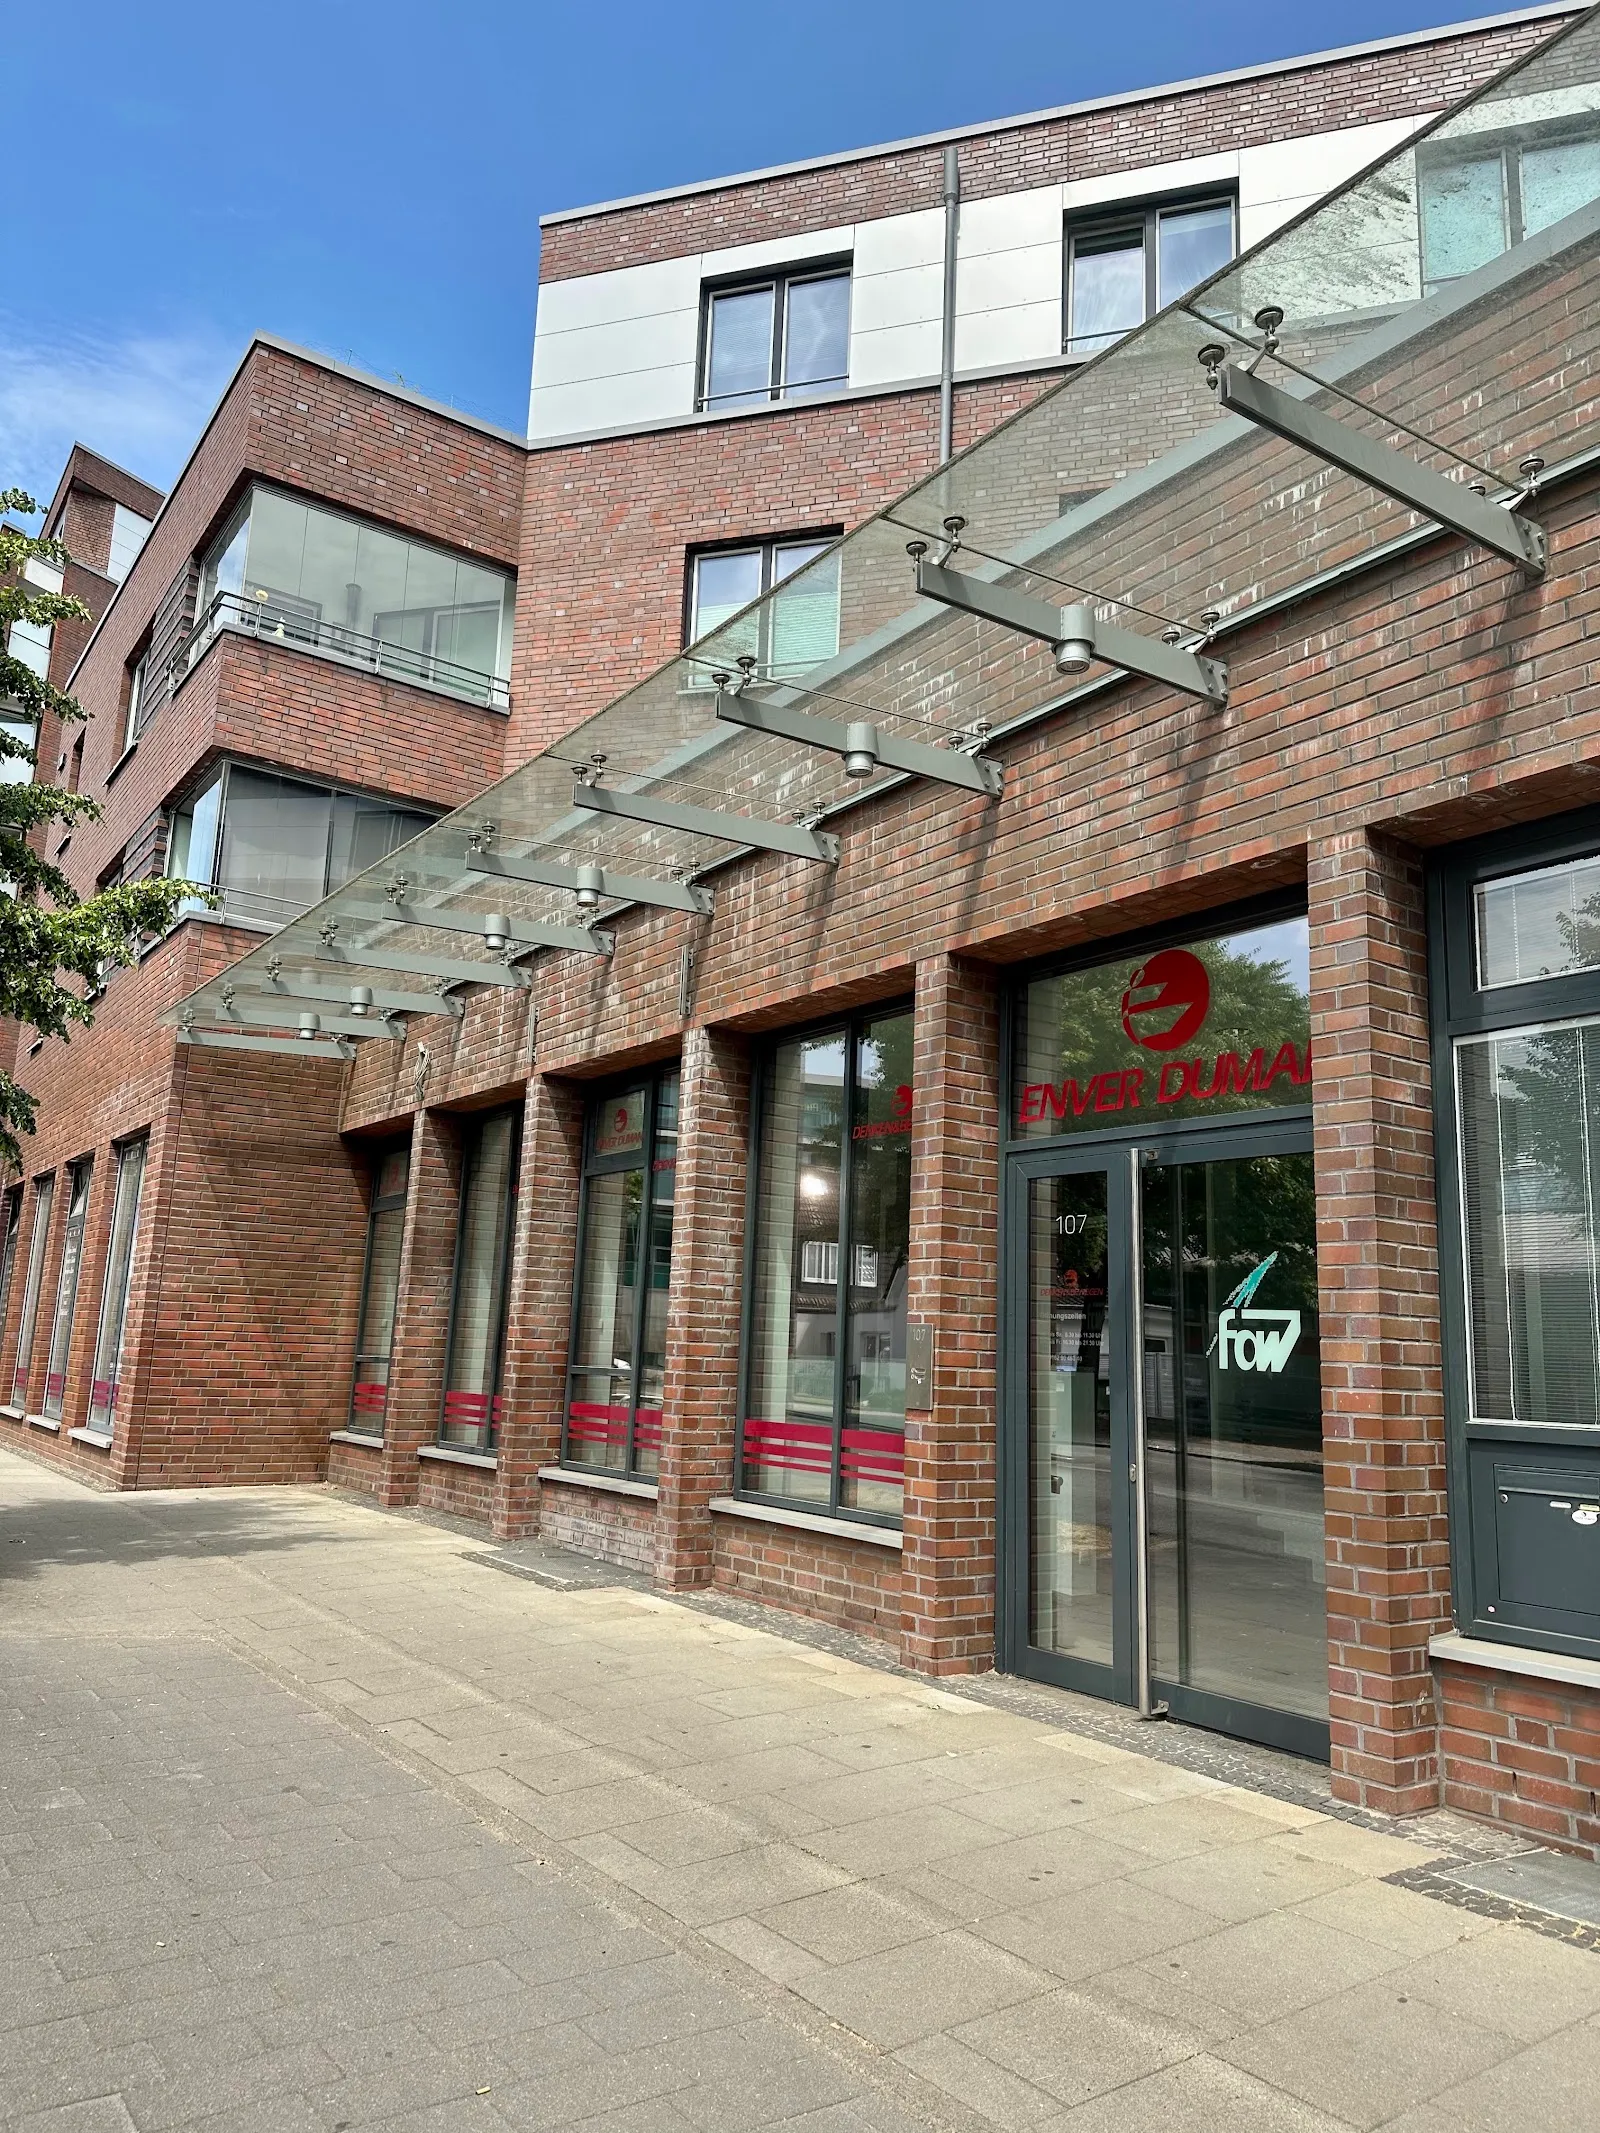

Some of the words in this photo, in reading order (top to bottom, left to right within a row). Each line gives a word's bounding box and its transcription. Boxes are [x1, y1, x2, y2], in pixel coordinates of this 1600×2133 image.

[1018, 1068, 1144, 1124] ENVER
[1055, 1214, 1087, 1235] 107
[912, 1328, 926, 1341] 107
